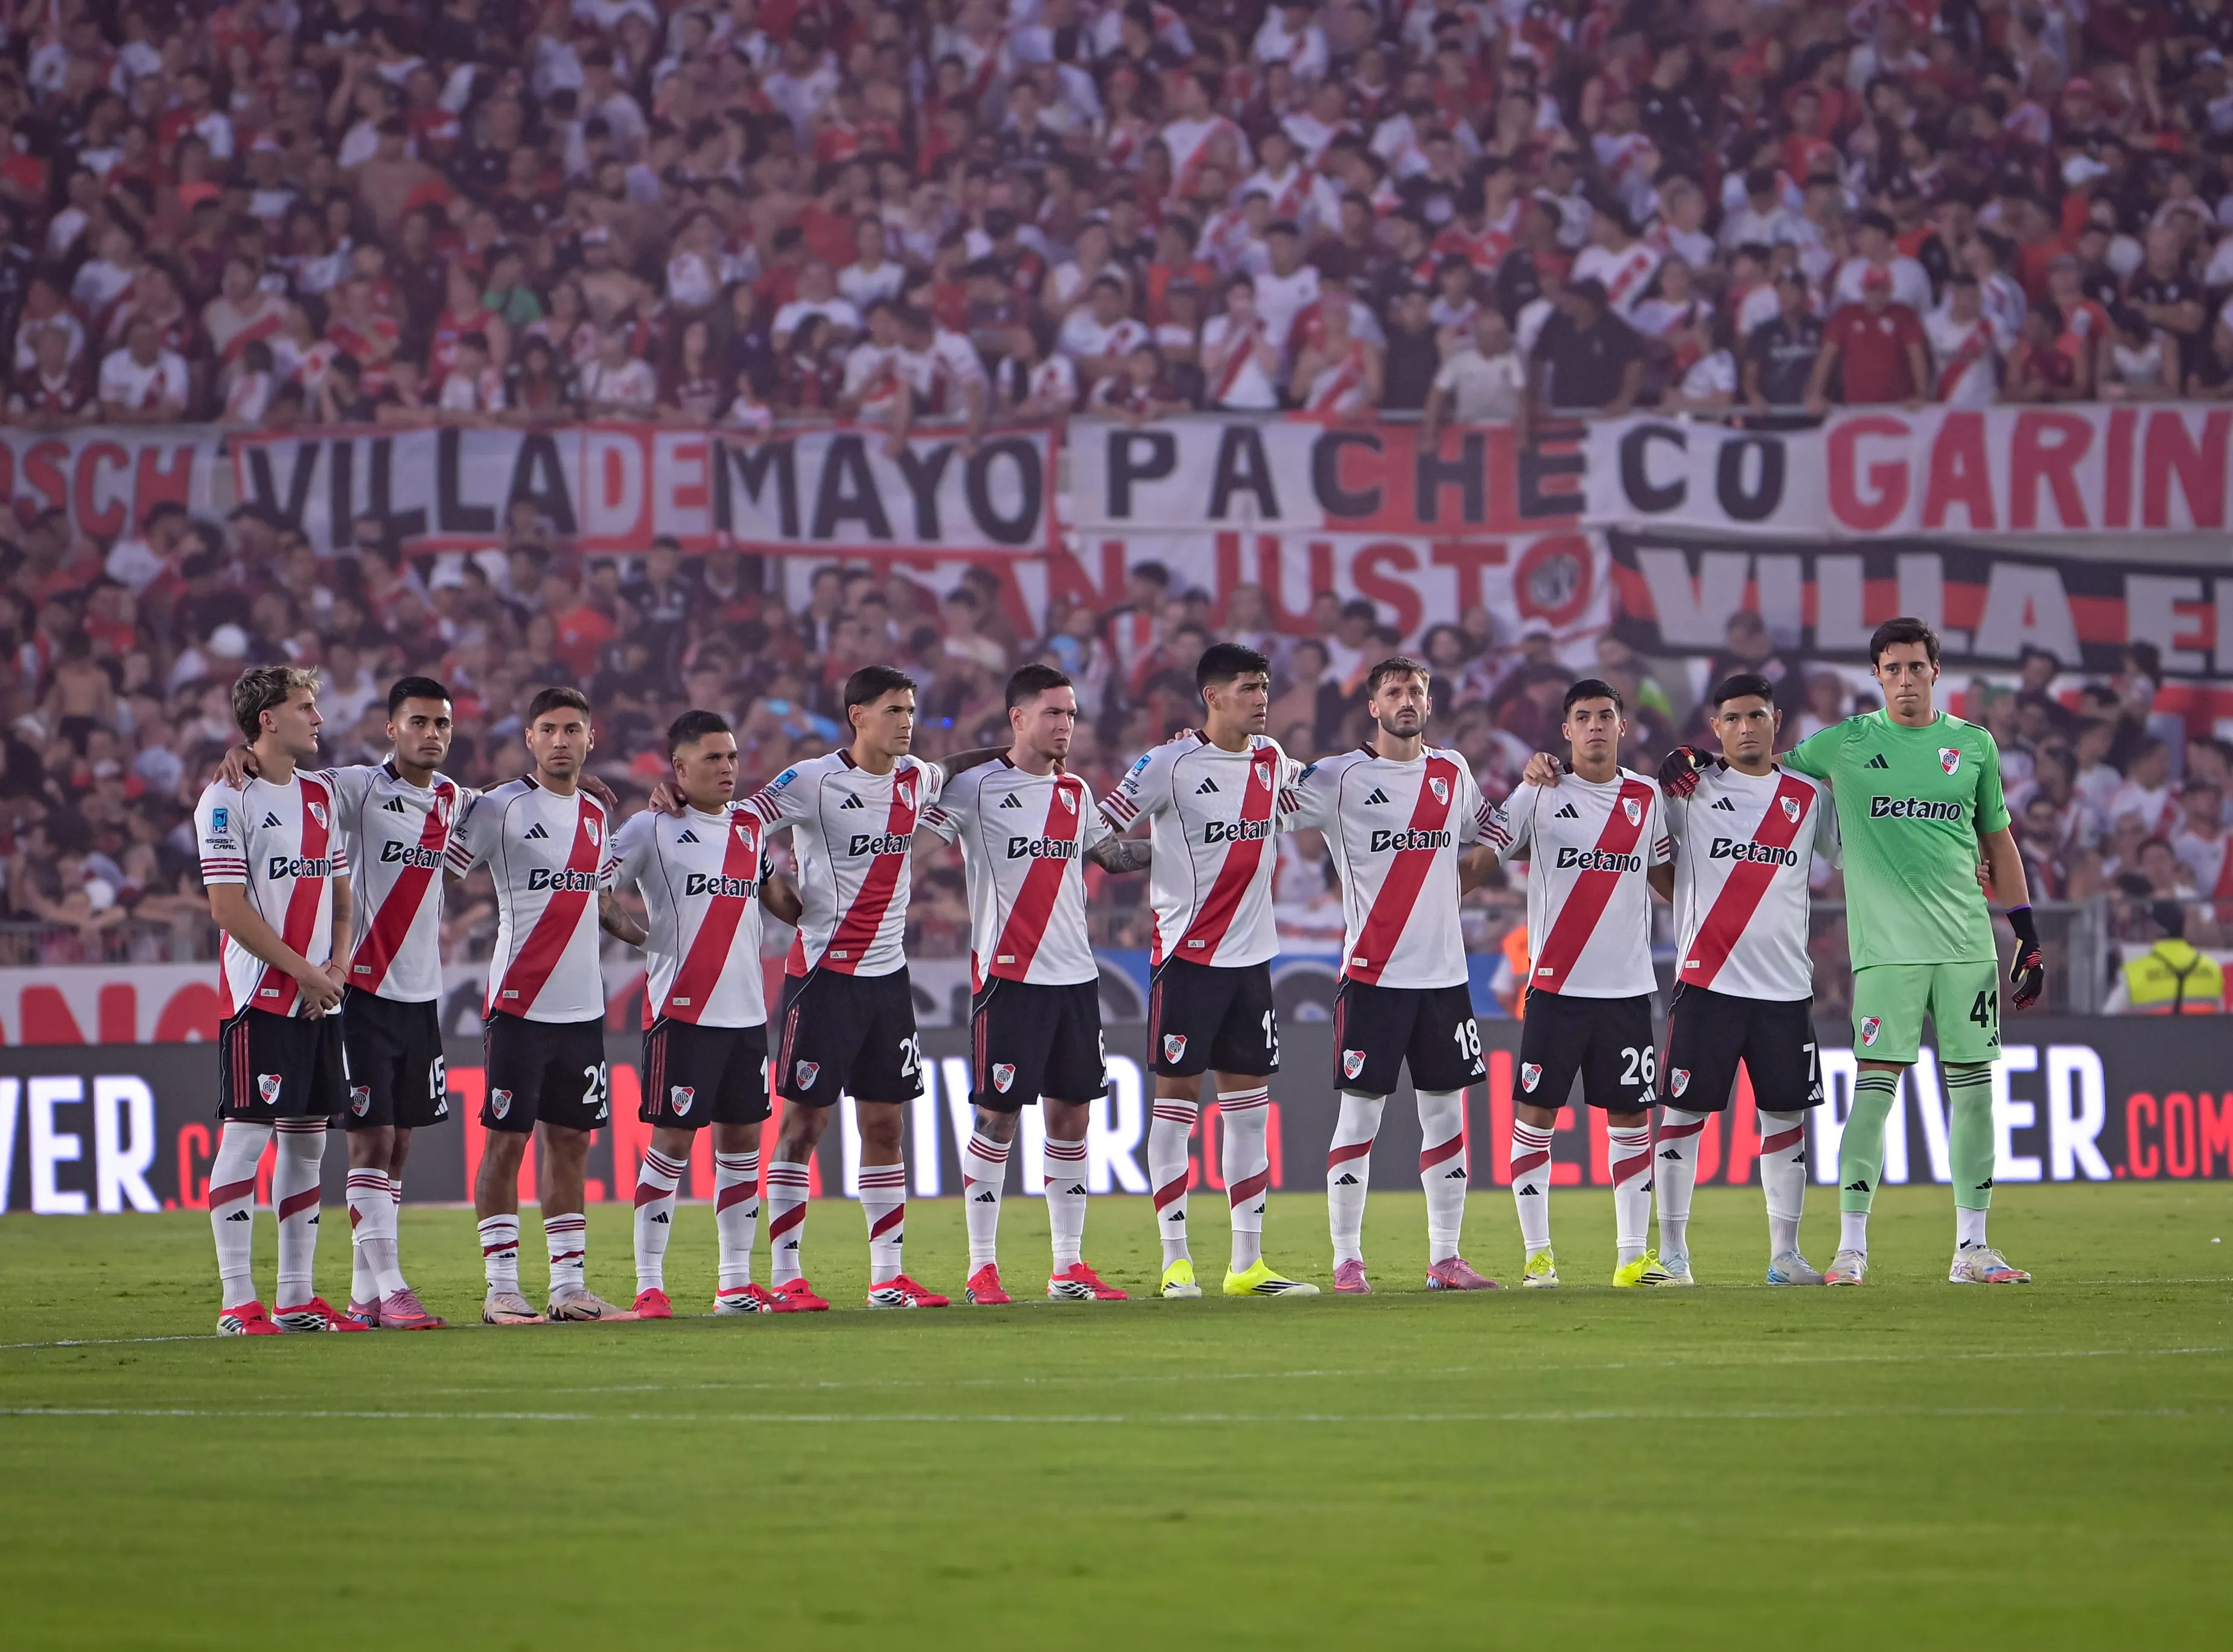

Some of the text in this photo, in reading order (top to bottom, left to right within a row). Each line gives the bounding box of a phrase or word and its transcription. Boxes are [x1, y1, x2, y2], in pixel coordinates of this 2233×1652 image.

[247, 428, 1043, 548] VILLA DE MAYO
[1637, 548, 2083, 667] VILLA
[1870, 796, 1961, 821] Betano
[1007, 836, 1078, 859] Betano
[1370, 827, 1451, 852] Betano
[1709, 837, 1797, 866] Betano
[1556, 847, 1641, 872] Betano
[686, 874, 758, 899] Betano
[1970, 990, 1998, 1028] 41
[1454, 1018, 1481, 1060] 18
[428, 1055, 446, 1099] 15
[1620, 1046, 1655, 1085] 26
